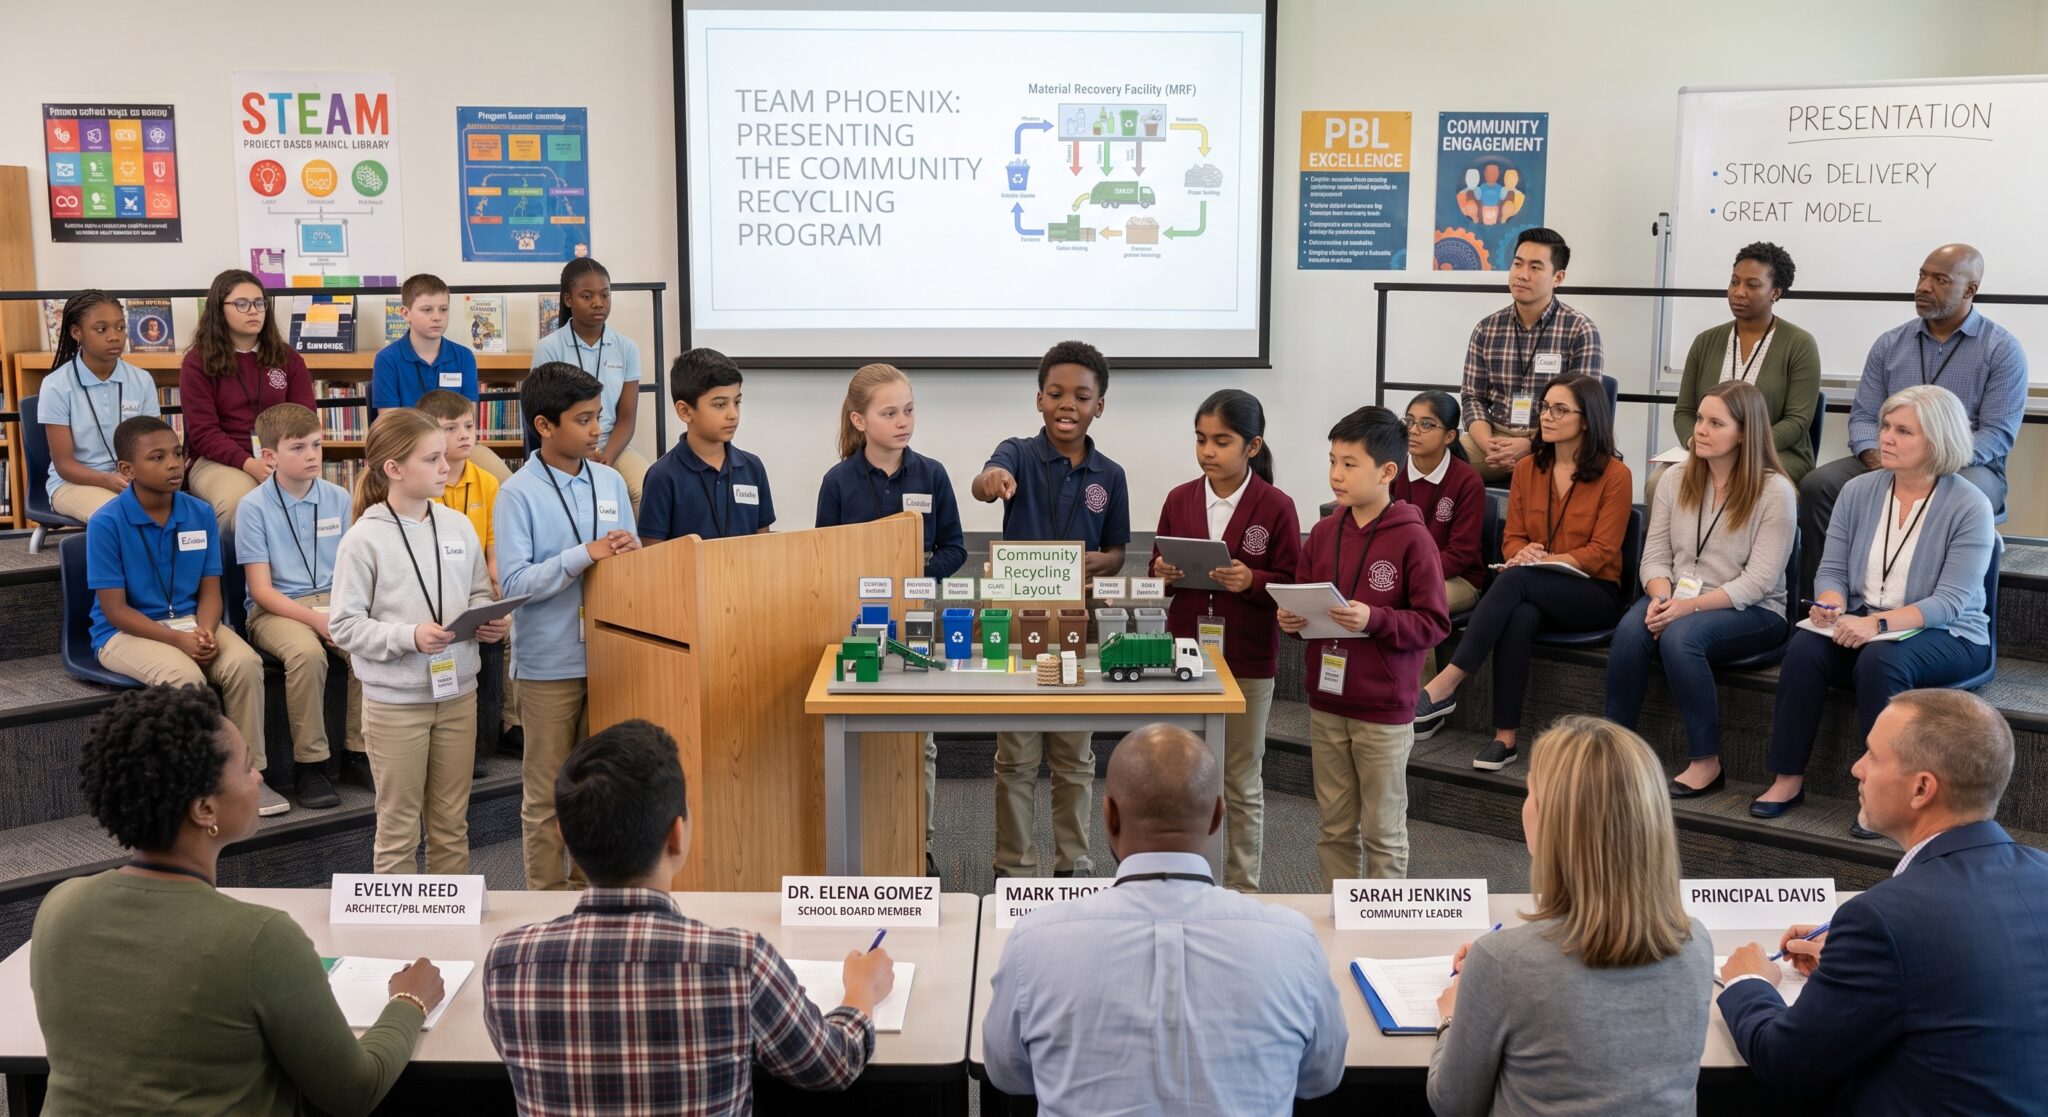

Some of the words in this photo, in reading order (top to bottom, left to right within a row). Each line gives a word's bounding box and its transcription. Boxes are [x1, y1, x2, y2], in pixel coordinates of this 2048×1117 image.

[1028, 83, 1071, 94] Material
[1075, 83, 1122, 97] Recovery
[1125, 84, 1162, 98] Facility
[1165, 84, 1197, 97] (MRF)
[735, 89, 814, 113] TEAM
[826, 89, 960, 113] PHOENIX:
[242, 92, 389, 135] STEAM
[1789, 102, 1992, 132] PRESENTATION
[737, 123, 914, 147] PRESENTING
[1324, 117, 1390, 149] PBL
[1447, 119, 1540, 135] COMMUNITY
[352, 140, 389, 149] LIBRARY
[1443, 136, 1544, 152] ENGAGEMENT
[1309, 152, 1403, 168] EXCELLENCE
[735, 156, 791, 180] THE
[800, 156, 983, 181] COMMUNITY
[1724, 162, 1812, 185] STRONG
[1827, 162, 1937, 189] DELIVERY
[738, 189, 896, 214] RECYCLING
[1722, 201, 1793, 222] GREAT
[1805, 202, 1882, 223] MODEL
[738, 223, 882, 247] PROGRAM
[996, 548, 1078, 563] Community
[1004, 565, 1071, 582] Recycling
[1014, 583, 1062, 597] Layout
[354, 882, 414, 898] EVELYN
[418, 883, 458, 898] REED
[788, 885, 814, 899] DR.
[819, 885, 870, 900] ELENA
[873, 885, 933, 900] GOMEZ
[1006, 887, 1054, 900] MARK
[1349, 888, 1403, 903] SARAH
[1407, 888, 1472, 903] JENKINS
[1691, 888, 1774, 903] PRINCIPAL
[1778, 887, 1826, 903] DAVIS
[344, 903, 420, 915] ARCHITECT/PBL
[422, 904, 466, 914] MENTOR
[798, 906, 838, 916] SCHOOL
[840, 906, 875, 916] BOARD
[877, 906, 922, 916] MEMBER
[1360, 909, 1424, 919] COMMUNITY
[1425, 908, 1463, 918] LEADER
